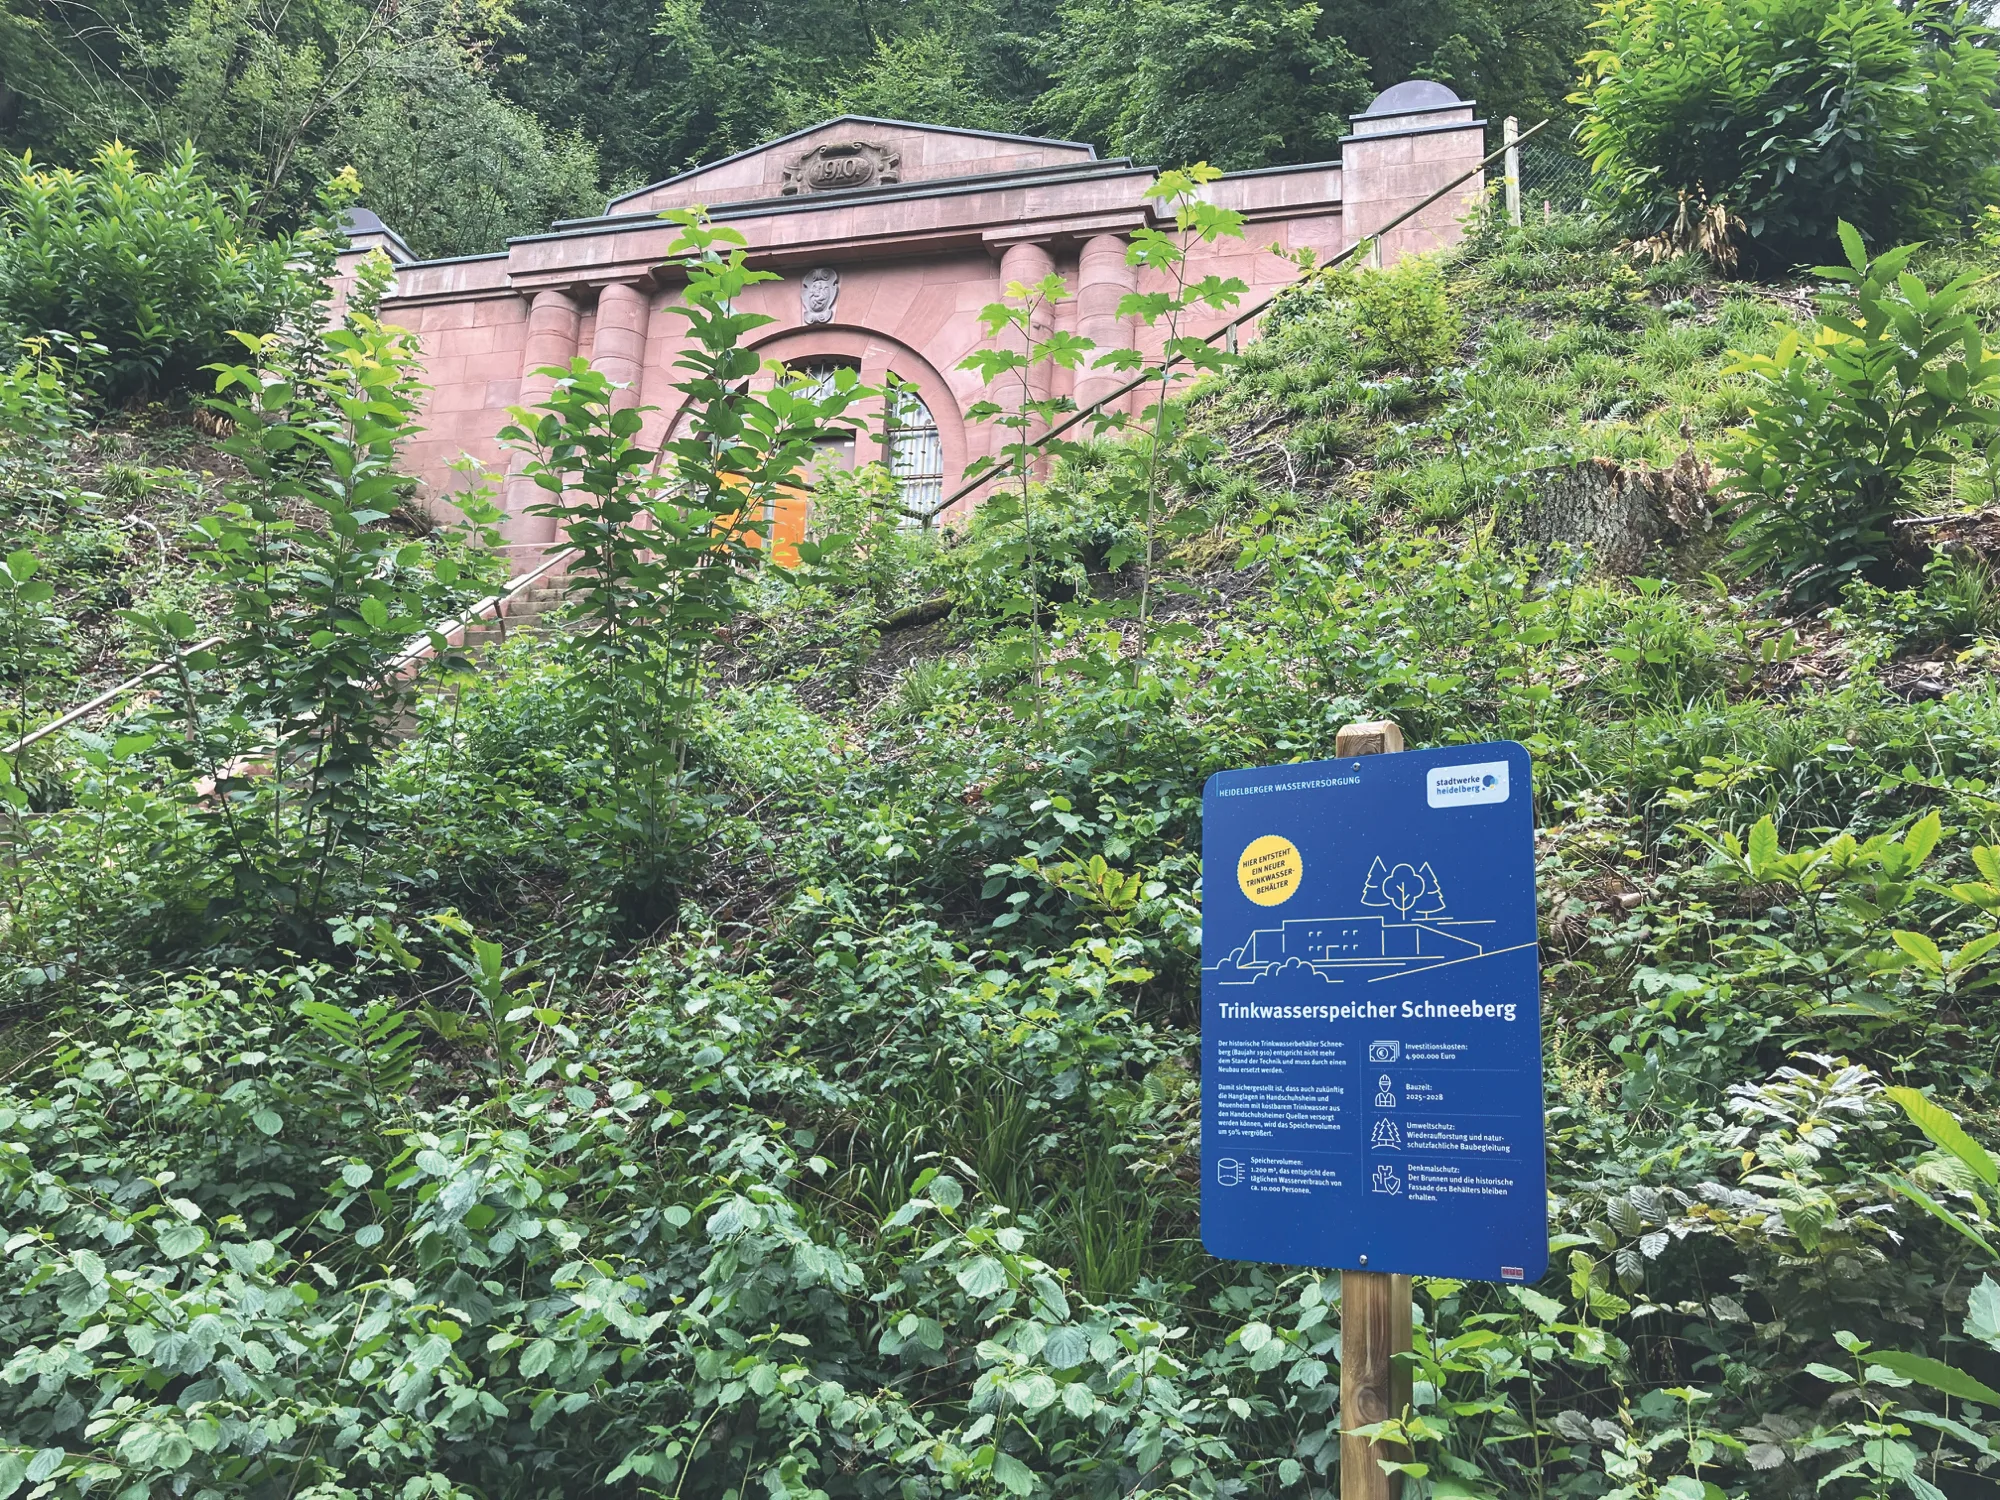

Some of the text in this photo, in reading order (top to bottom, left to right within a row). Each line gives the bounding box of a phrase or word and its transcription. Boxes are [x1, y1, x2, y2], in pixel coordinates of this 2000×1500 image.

[1436, 776, 1480, 786] stadtwerke
[1219, 777, 1360, 797] HEIDELBERGER WASSERVERSORGUNG
[1436, 785, 1480, 795] heidelberg
[1243, 848, 1291, 868] HIER ENTSTEHT
[1252, 860, 1285, 875] EIN NEUER
[1246, 868, 1295, 887] TRINKWASSER-
[1256, 880, 1288, 895] BEHÄLTER
[1219, 999, 1517, 1022] Trinkwasserspeicher Schneeberg
[1218, 1049, 1231, 1057] berg
[1273, 1049, 1303, 1057] entspricht
[1440, 1052, 1456, 1060] Euro
[1236, 1084, 1274, 1092] sichergestellt
[1315, 1086, 1344, 1094] zukünftig
[1406, 1083, 1432, 1091] Bauzeit:
[1228, 1093, 1258, 1101] Hanglagen
[1218, 1101, 1250, 1109] Neuenheim
[1261, 1102, 1292, 1110] kostbarem
[1293, 1103, 1328, 1111] Trinkwasser
[1230, 1111, 1285, 1119] Handschuhsheimer
[1285, 1112, 1309, 1120] Quellen
[1309, 1114, 1334, 1122] versorgt
[1240, 1120, 1263, 1128] können,
[1289, 1121, 1341, 1130] Speichervolumen
[1406, 1122, 1455, 1130] Umweltschutz:
[1241, 1129, 1273, 1137] vergrößert.
[1406, 1131, 1468, 1142] Wiederaufforstung
[1469, 1133, 1482, 1141] und
[1407, 1141, 1510, 1153] schutzfachliche Baubegleitung
[1250, 1156, 1303, 1165] Speichervolumen:
[1408, 1164, 1460, 1173] Denkmalschutz:
[1250, 1175, 1278, 1183] täglichen
[1278, 1176, 1330, 1186] Wasserverbrauch
[1408, 1173, 1420, 1181] Der
[1421, 1174, 1448, 1182] Brunnen
[1463, 1176, 1474, 1184] die
[1475, 1177, 1513, 1186] historische
[1281, 1186, 1311, 1194] Personen.
[1408, 1183, 1435, 1191] Fassade
[1449, 1185, 1481, 1194] Behälters
[1482, 1187, 1508, 1195] bleiben
[1408, 1193, 1437, 1201] erhalten.
